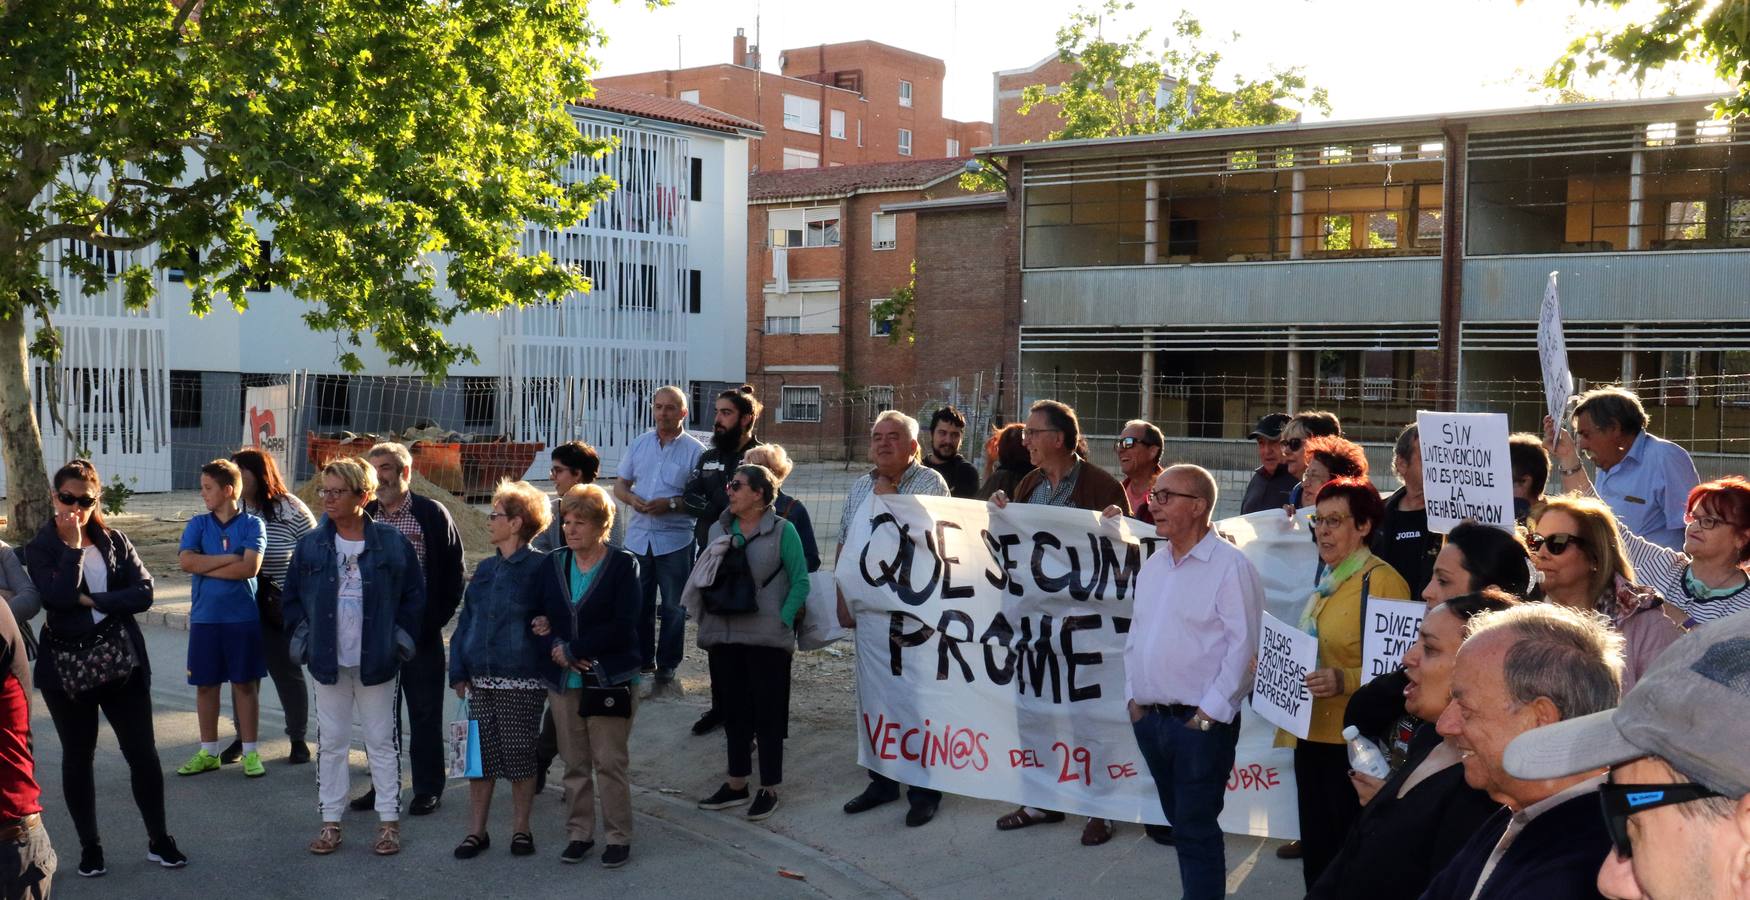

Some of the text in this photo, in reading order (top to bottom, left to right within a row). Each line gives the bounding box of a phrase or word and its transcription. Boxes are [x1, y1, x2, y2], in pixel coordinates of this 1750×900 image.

[1426, 467, 1437, 483] NO
[1440, 469, 1452, 484] ES
[1451, 487, 1465, 502] LA
[860, 512, 975, 606] QUE
[980, 528, 1024, 597] SE
[1264, 626, 1292, 656] FALSAS
[1258, 662, 1309, 701] SON LAS QUE
[1262, 646, 1307, 682] PROMESAS
[1256, 678, 1300, 717] EXPRESAN
[1009, 749, 1045, 769] DEL
[1052, 741, 1091, 786] 29
[1107, 763, 1138, 780] DE
